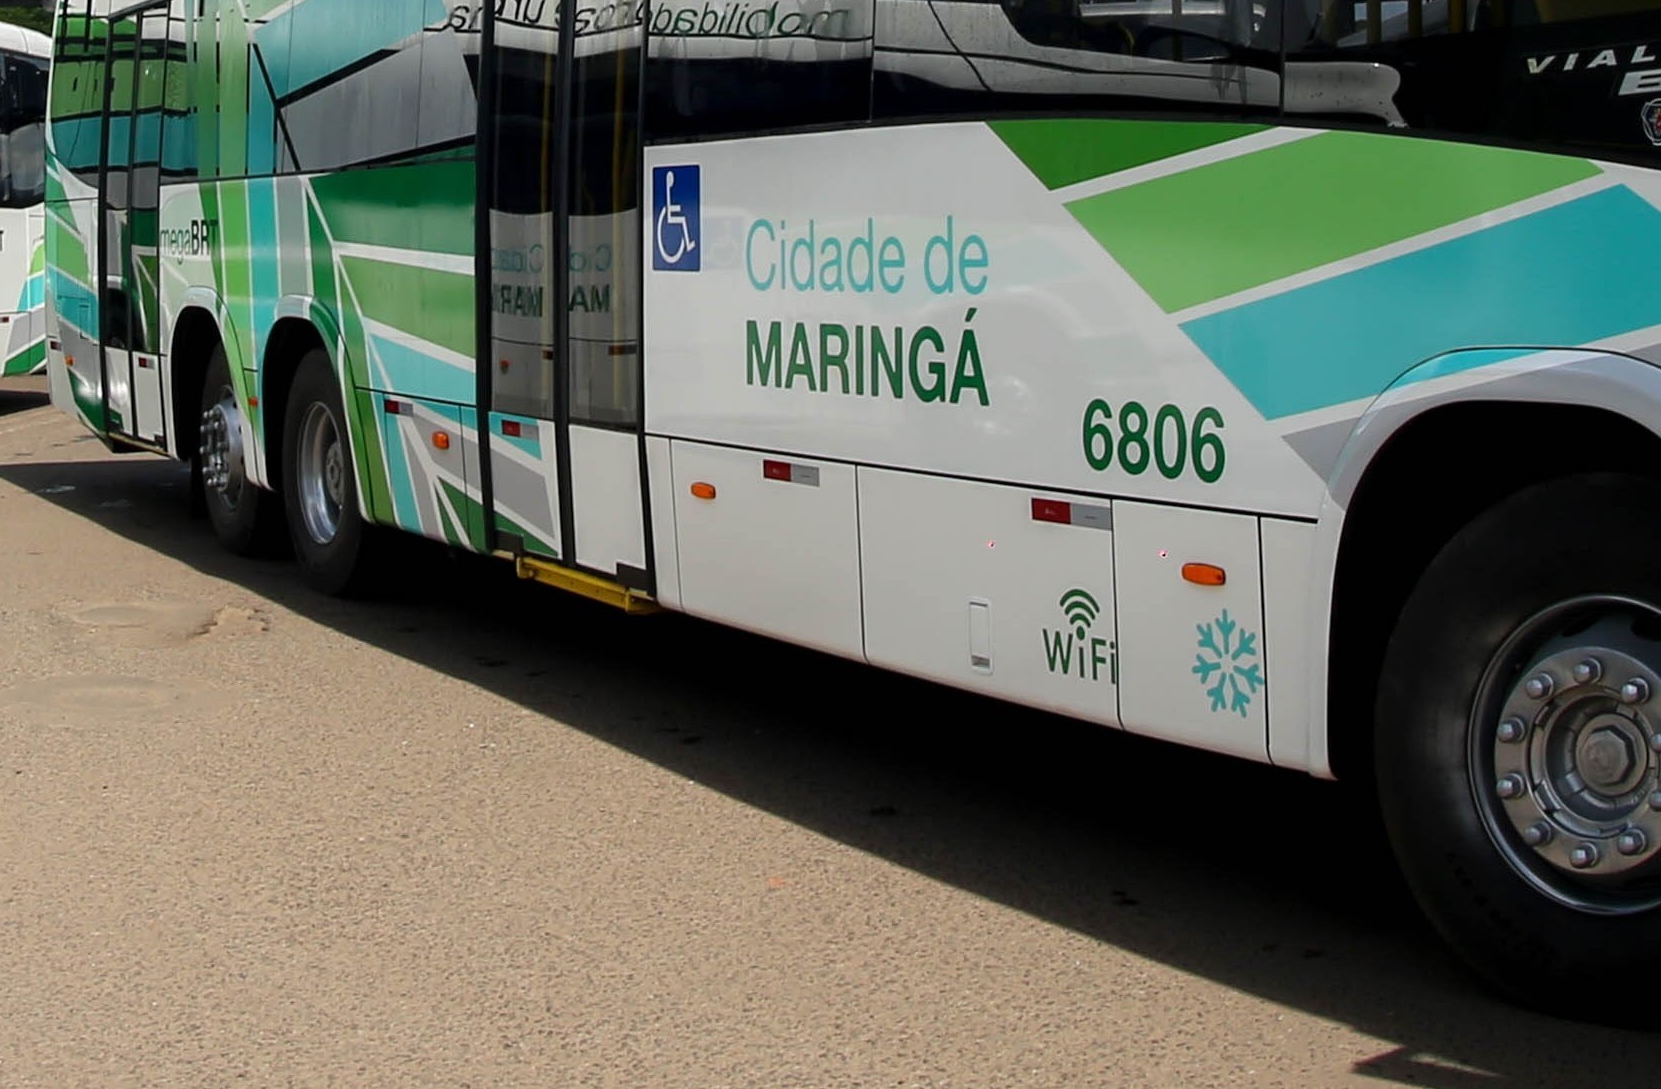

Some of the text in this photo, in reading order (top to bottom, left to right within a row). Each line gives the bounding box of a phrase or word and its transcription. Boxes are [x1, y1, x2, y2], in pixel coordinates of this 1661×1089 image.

[160, 219, 219, 265] megaBRT
[745, 214, 989, 296] Cidade de
[746, 307, 990, 407] MARINGÁ
[1082, 398, 1226, 484] 6806
[1042, 626, 1116, 685] WiFi
